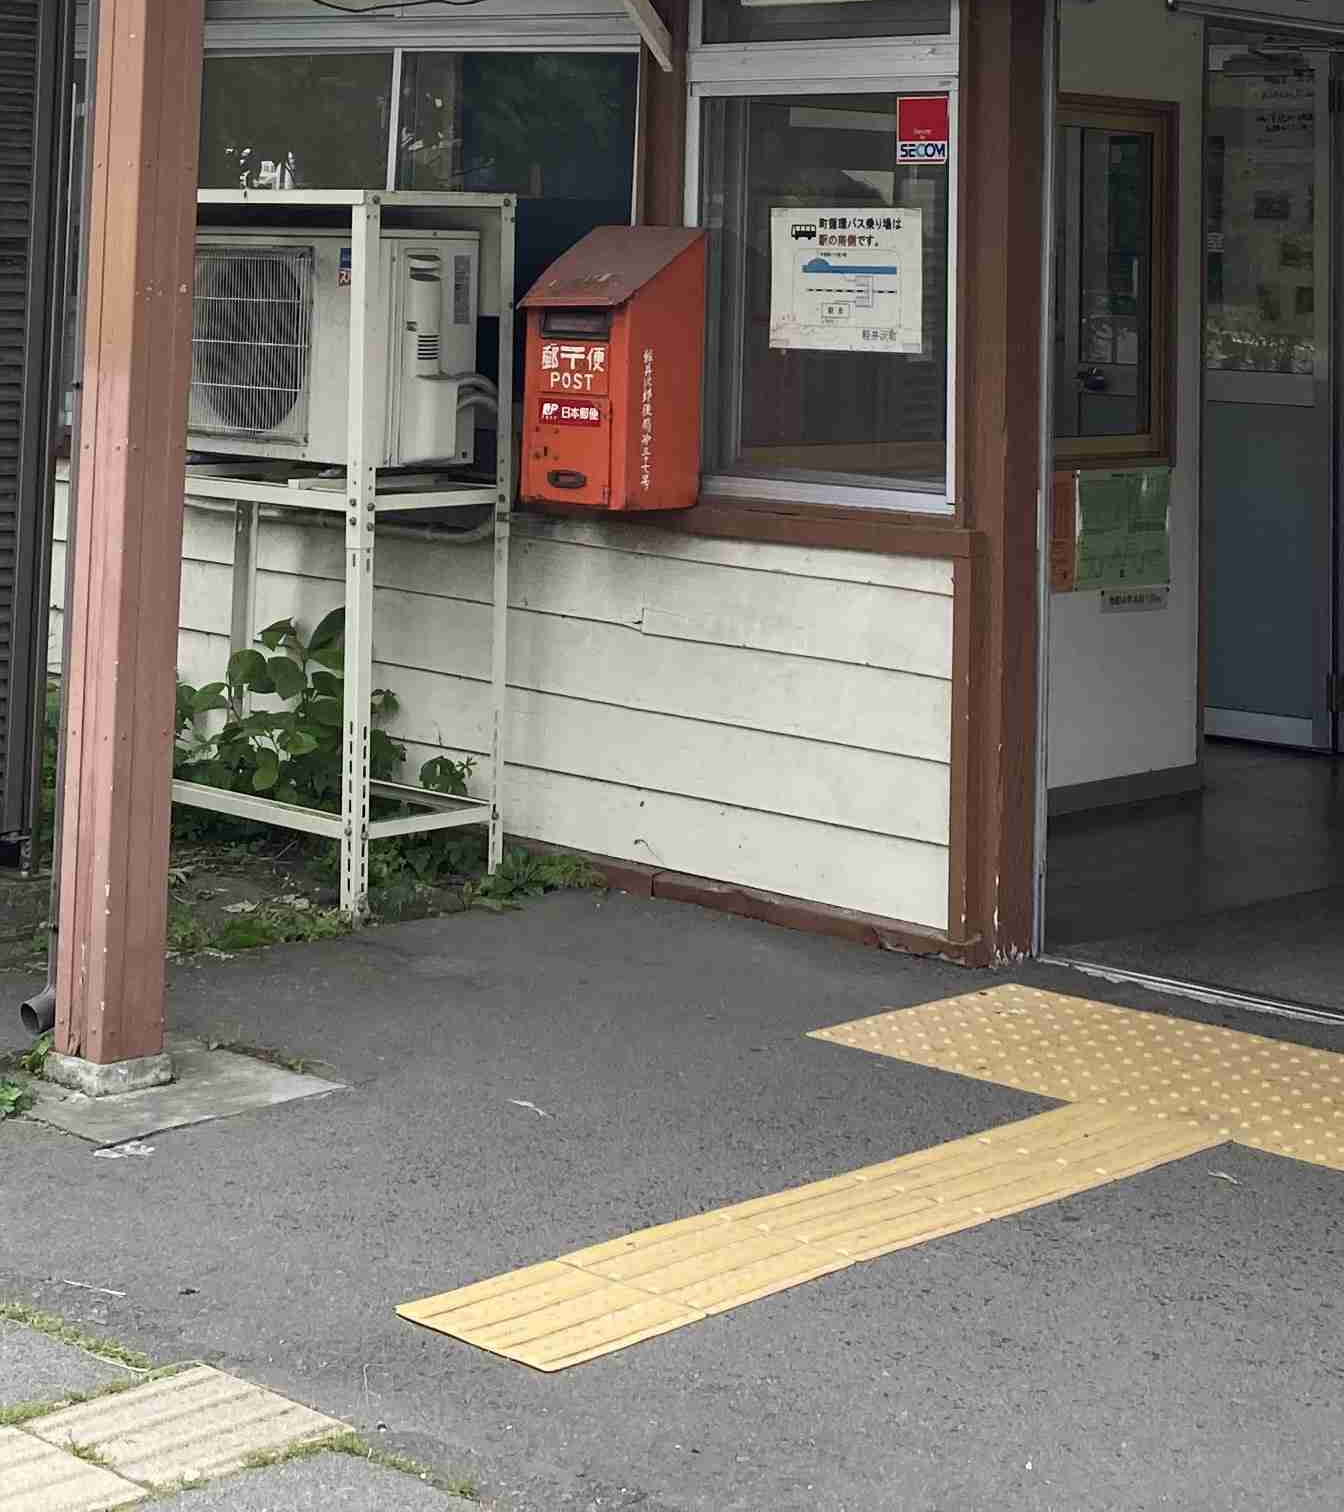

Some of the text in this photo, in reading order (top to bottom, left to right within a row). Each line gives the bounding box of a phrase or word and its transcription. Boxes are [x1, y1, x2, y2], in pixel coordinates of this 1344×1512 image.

[900, 143, 946, 158] SECOM
[550, 372, 594, 391] POST
[561, 406, 600, 421] 日本郵便
